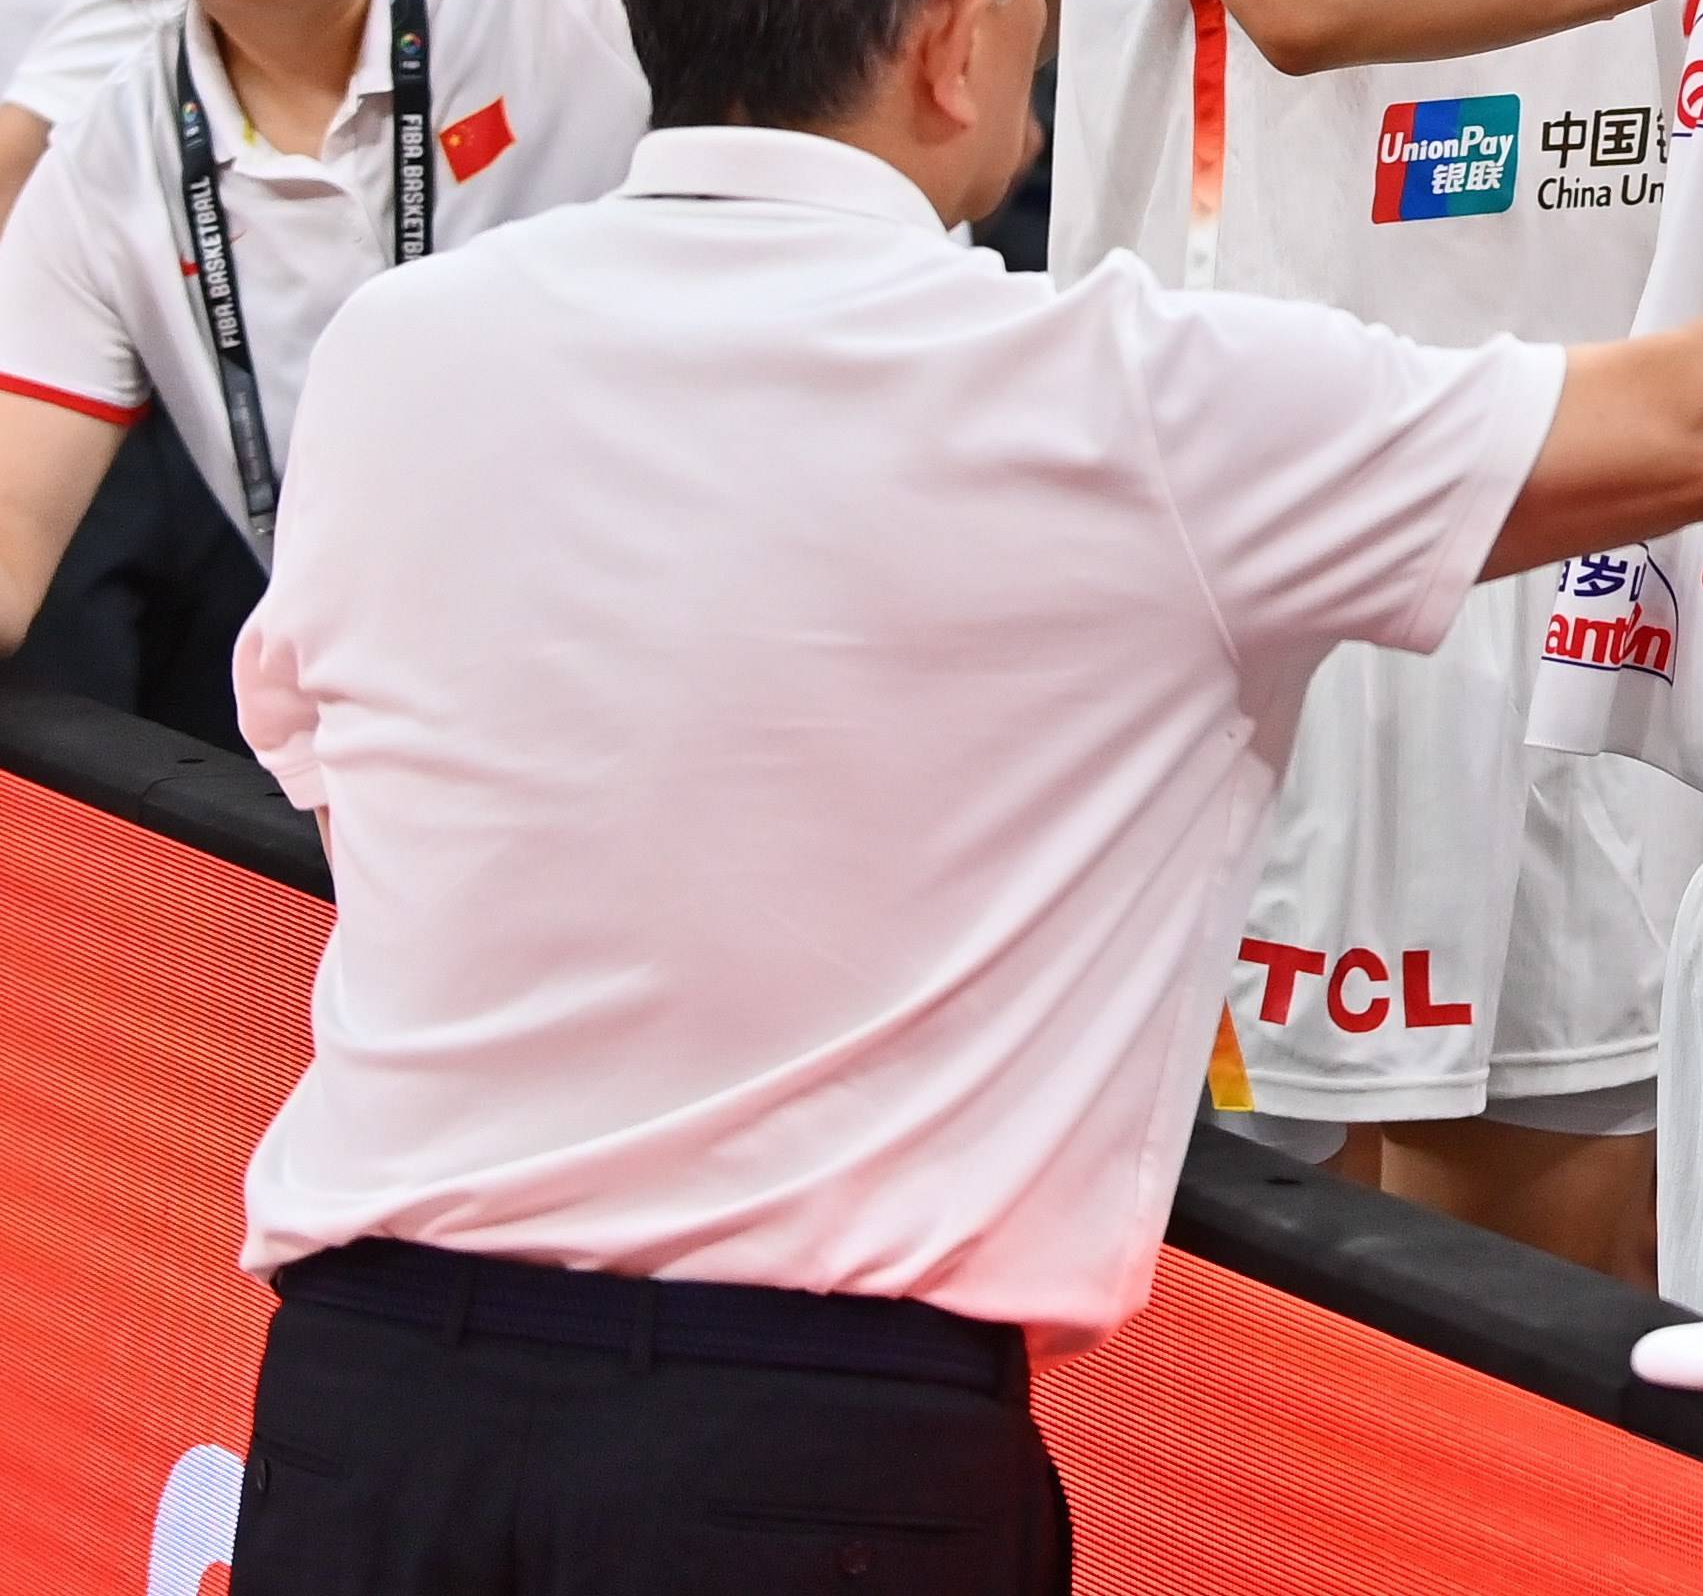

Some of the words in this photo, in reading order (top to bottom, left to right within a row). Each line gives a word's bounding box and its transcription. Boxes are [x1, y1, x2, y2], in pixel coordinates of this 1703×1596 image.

[1380, 124, 1514, 167] UnionPay
[1431, 159, 1505, 195] 银联
[1536, 175, 1612, 210] China
[190, 174, 242, 350] FIBA.BASKETBALL
[1236, 935, 1473, 1034] TCL
